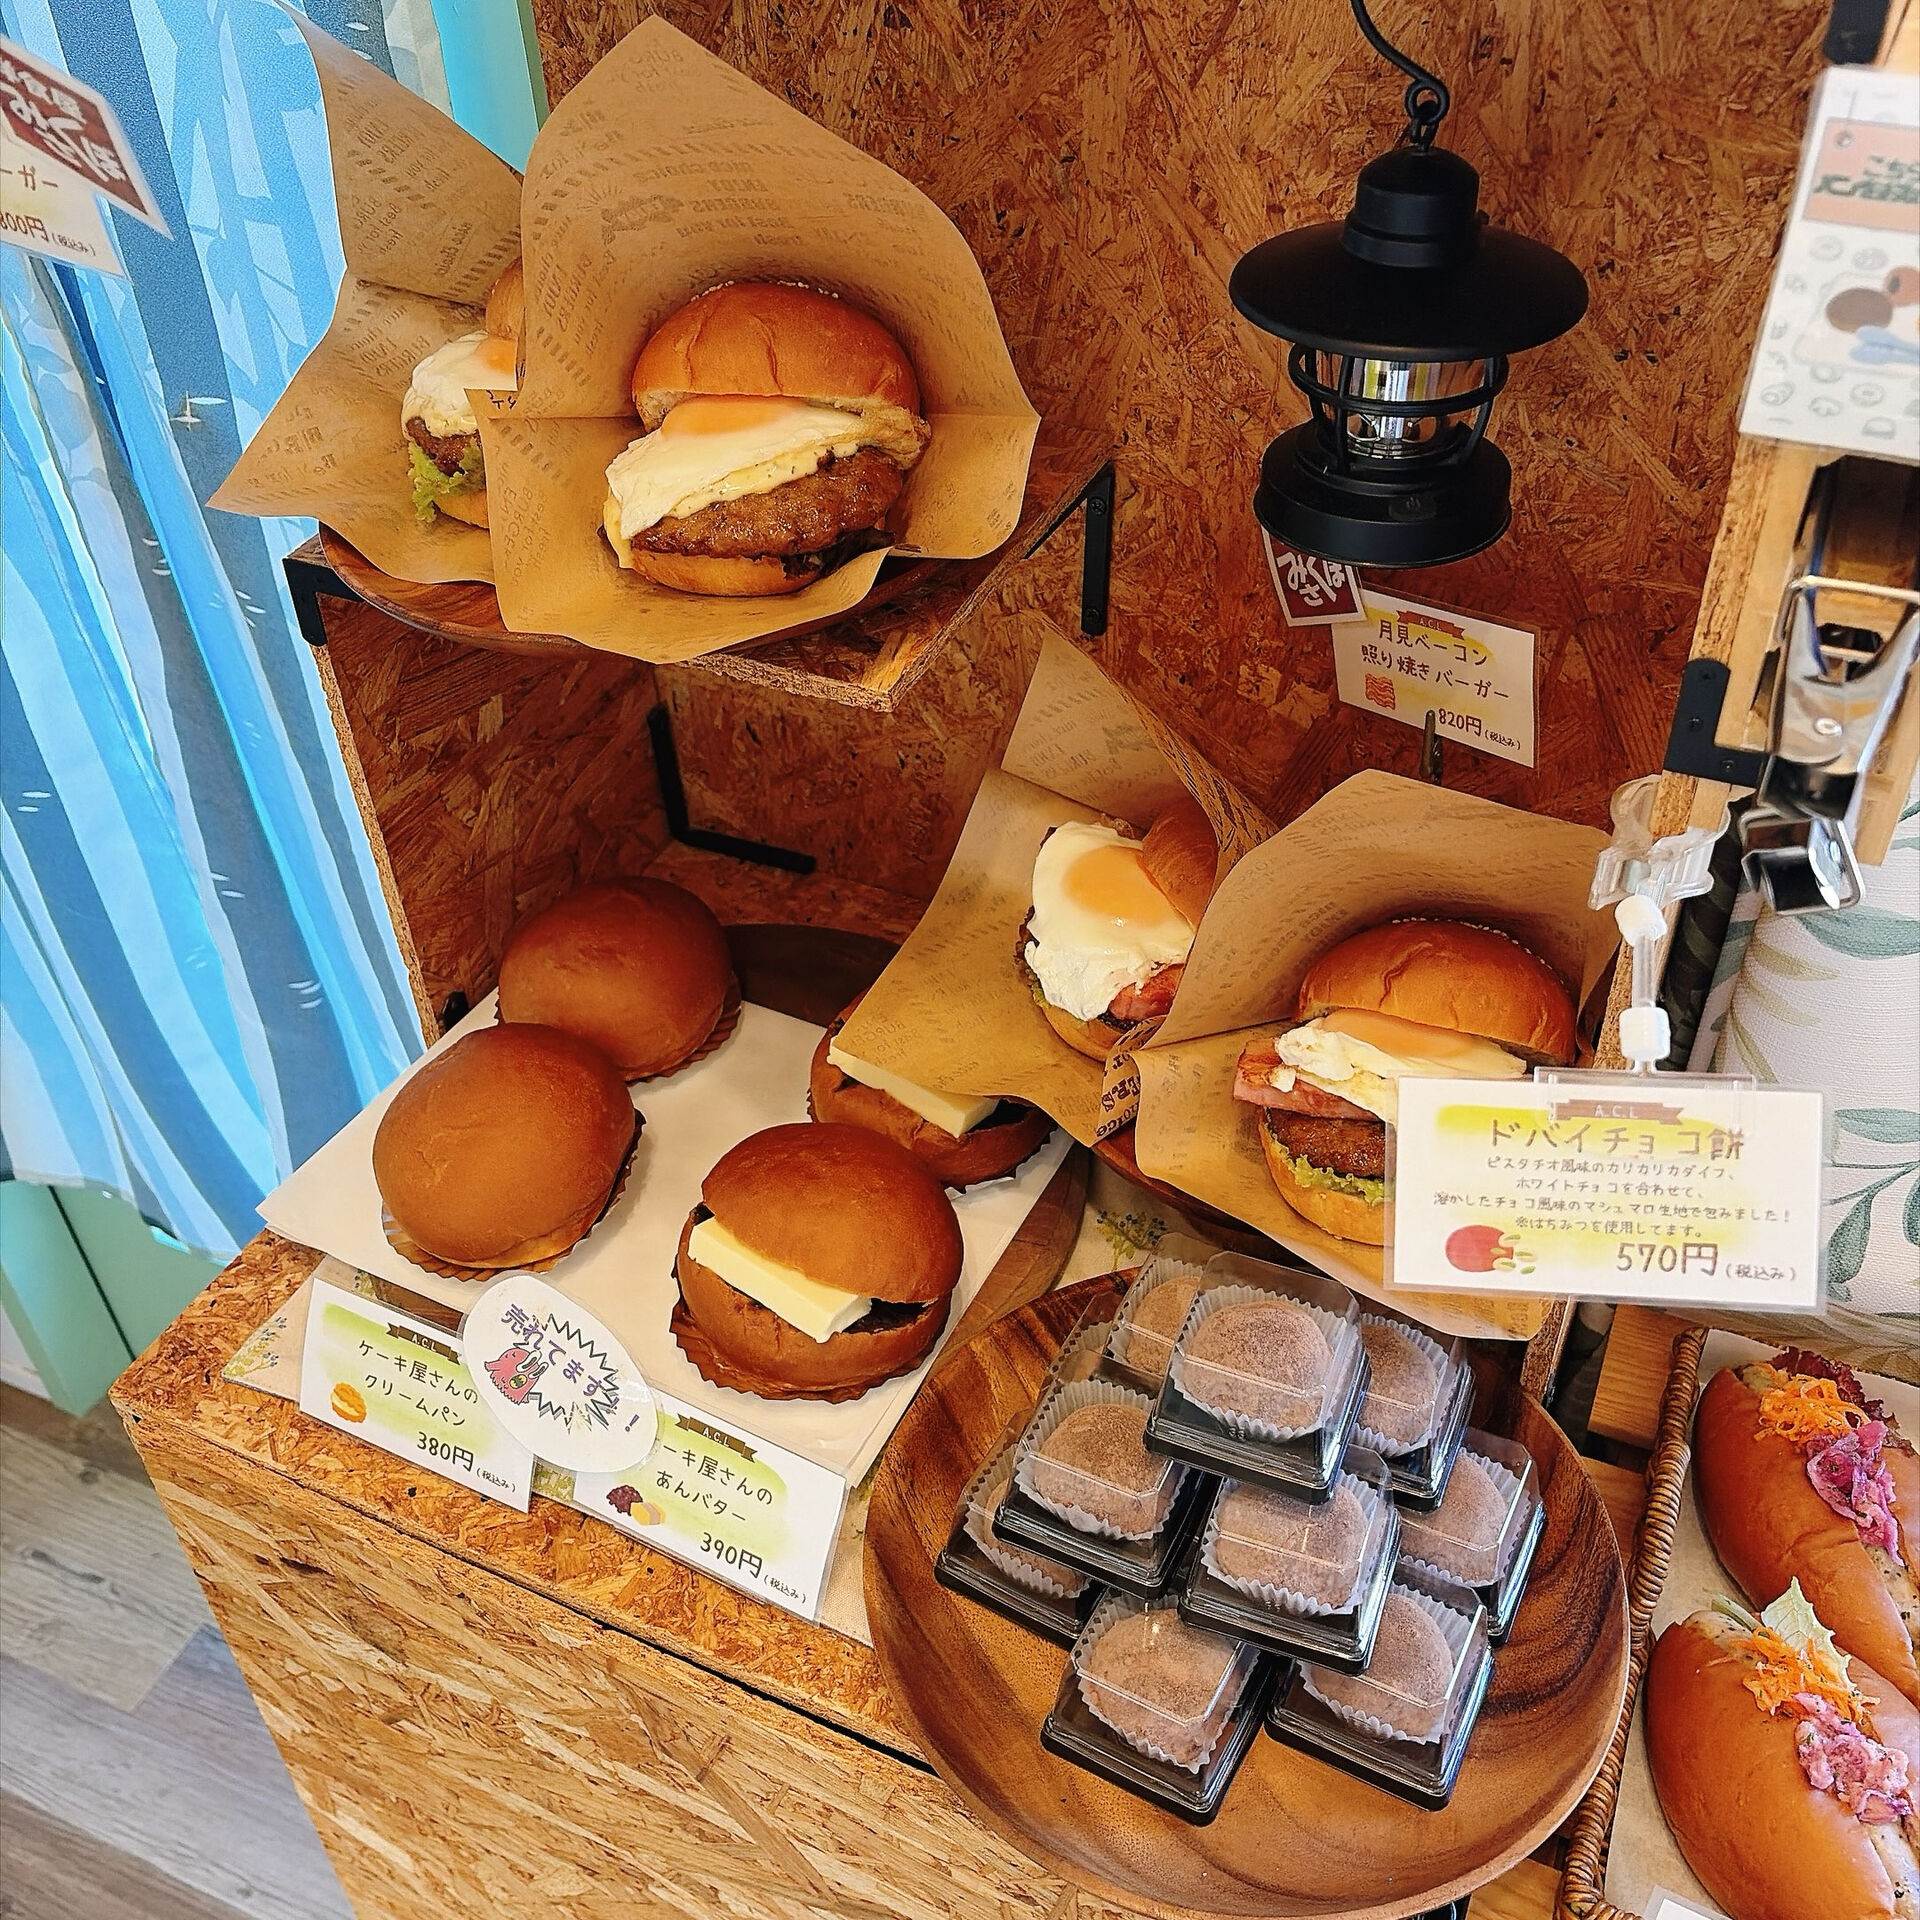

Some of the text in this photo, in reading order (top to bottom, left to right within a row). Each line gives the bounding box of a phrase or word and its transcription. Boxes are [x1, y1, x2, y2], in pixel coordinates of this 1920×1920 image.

[1379, 619, 1487, 666] 月見ベーコン
[1361, 644, 1509, 698] 照り焼きバーガー
[1438, 708, 1521, 750] 820円 (税込み)
[1492, 1119, 1744, 1160] ドバイチョコ餅
[1488, 1156, 1734, 1180] ピスタチオ風味のカリカリカダイフ、
[1516, 1177, 1703, 1199] ホワイトチョコを合わせて、
[1616, 1242, 1796, 1281] 570円 (税込み)
[359, 1340, 479, 1404] ケーキ屋さんの
[365, 1374, 466, 1426] クリームパン
[416, 1431, 516, 1493] 380円 (税込み)
[663, 1444, 772, 1505] ーキ屋さんの
[656, 1470, 746, 1522] あんバター
[699, 1532, 807, 1604] 390円 (税込み)
